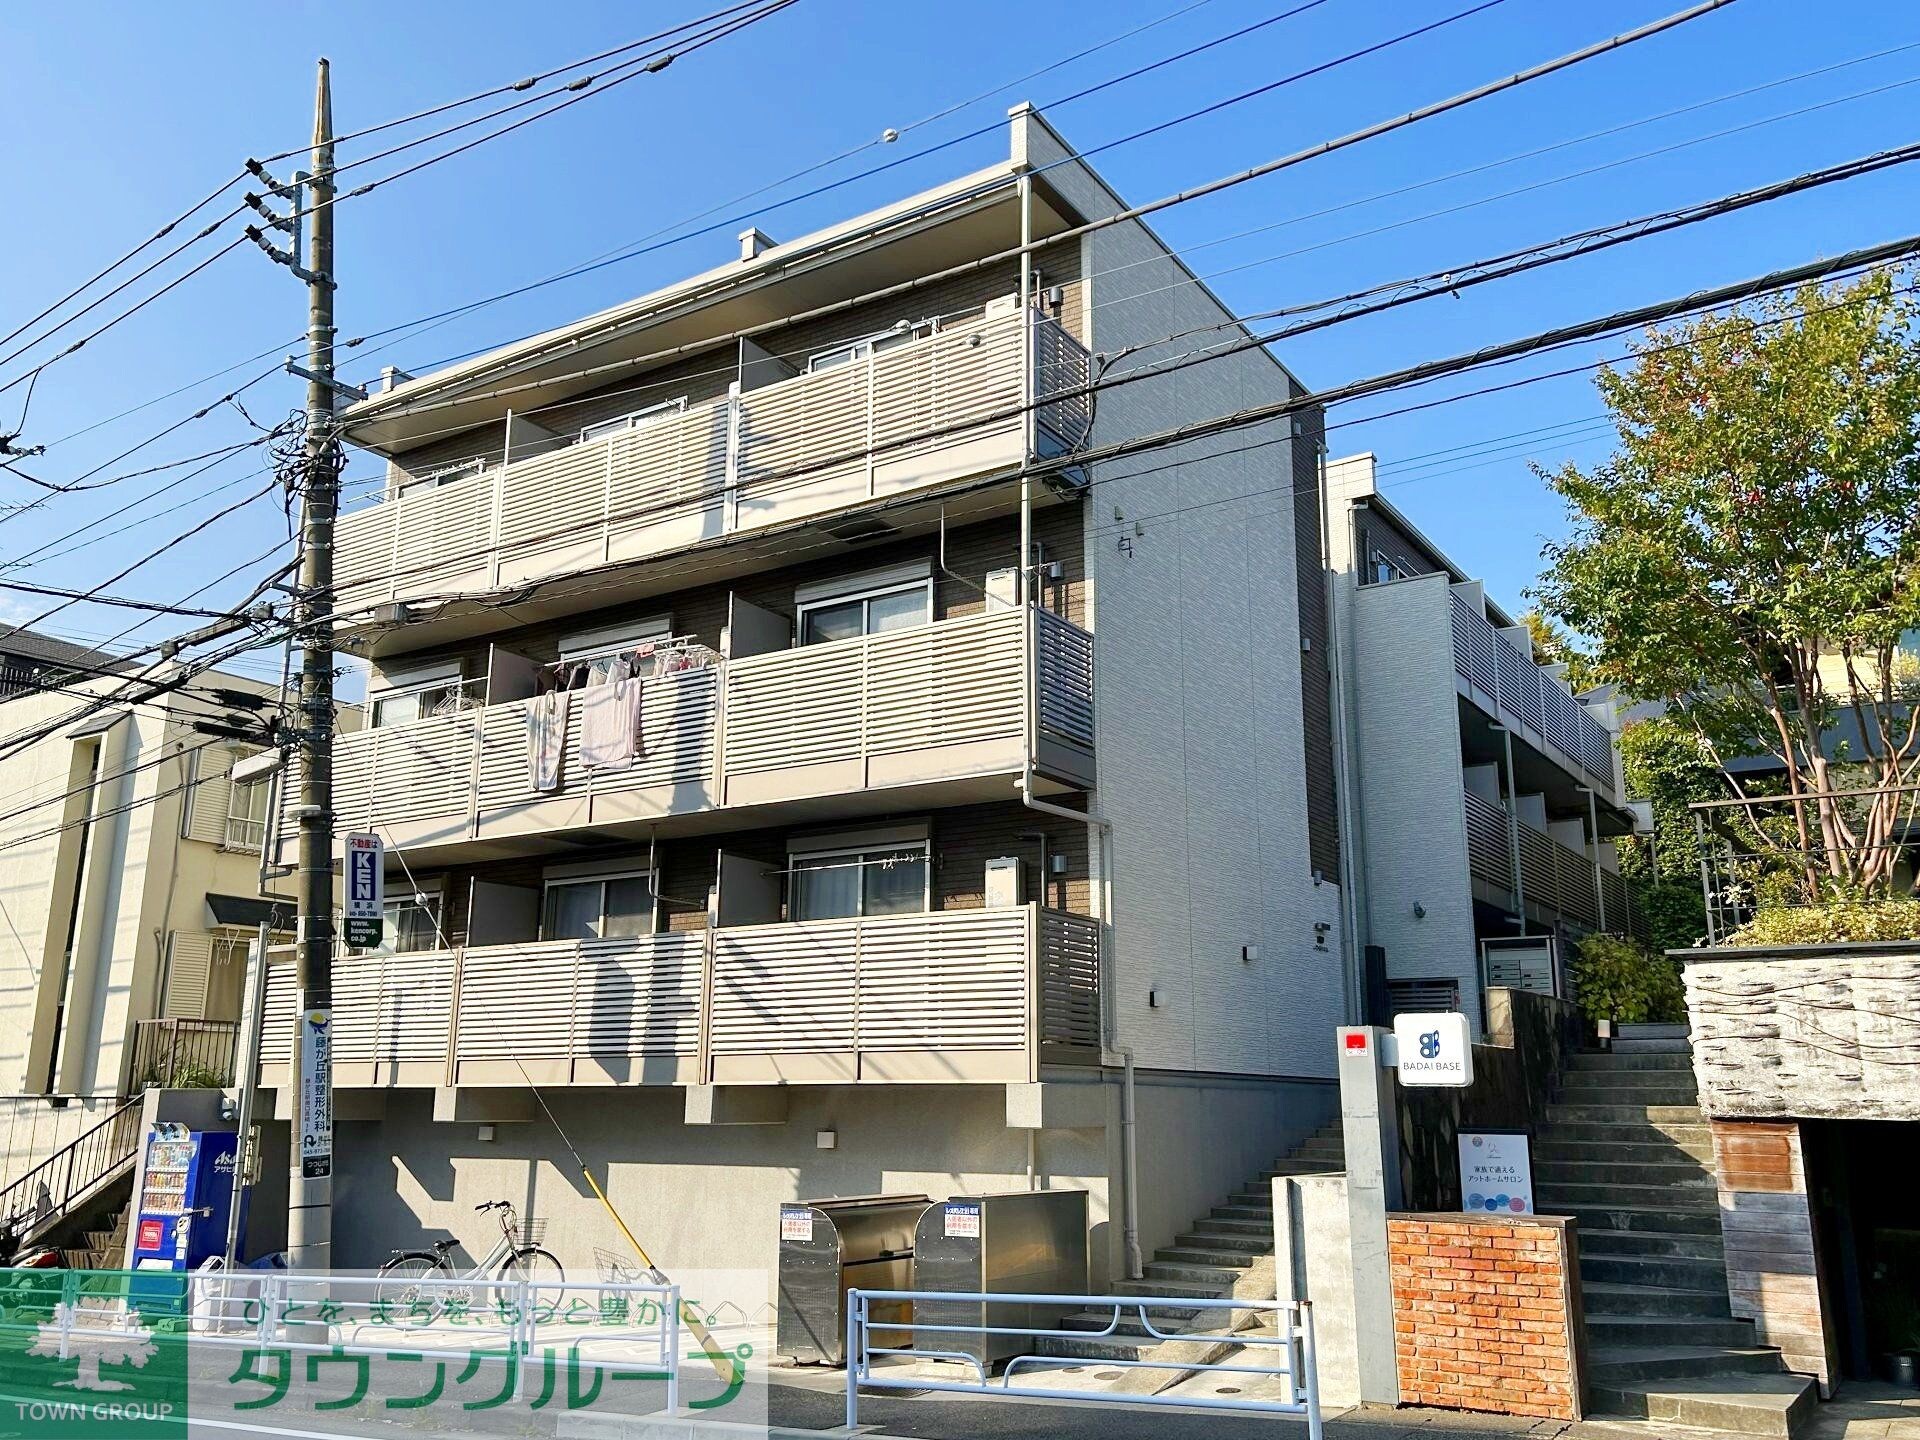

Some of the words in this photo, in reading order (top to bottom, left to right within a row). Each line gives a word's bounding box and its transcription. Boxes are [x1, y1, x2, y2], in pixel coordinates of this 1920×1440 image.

[350, 838, 378, 848] 不動産は
[356, 852, 371, 899] KEN
[350, 927, 378, 935] kencorp.
[1403, 1062, 1434, 1070] BADAI
[1436, 1062, 1461, 1071] BASE
[314, 1036, 326, 1132] 藤が丘駅整形外科
[214, 1151, 236, 1165] Asa
[1473, 1166, 1515, 1174] 家族で通える
[1468, 1175, 1523, 1183] アットホームサロン
